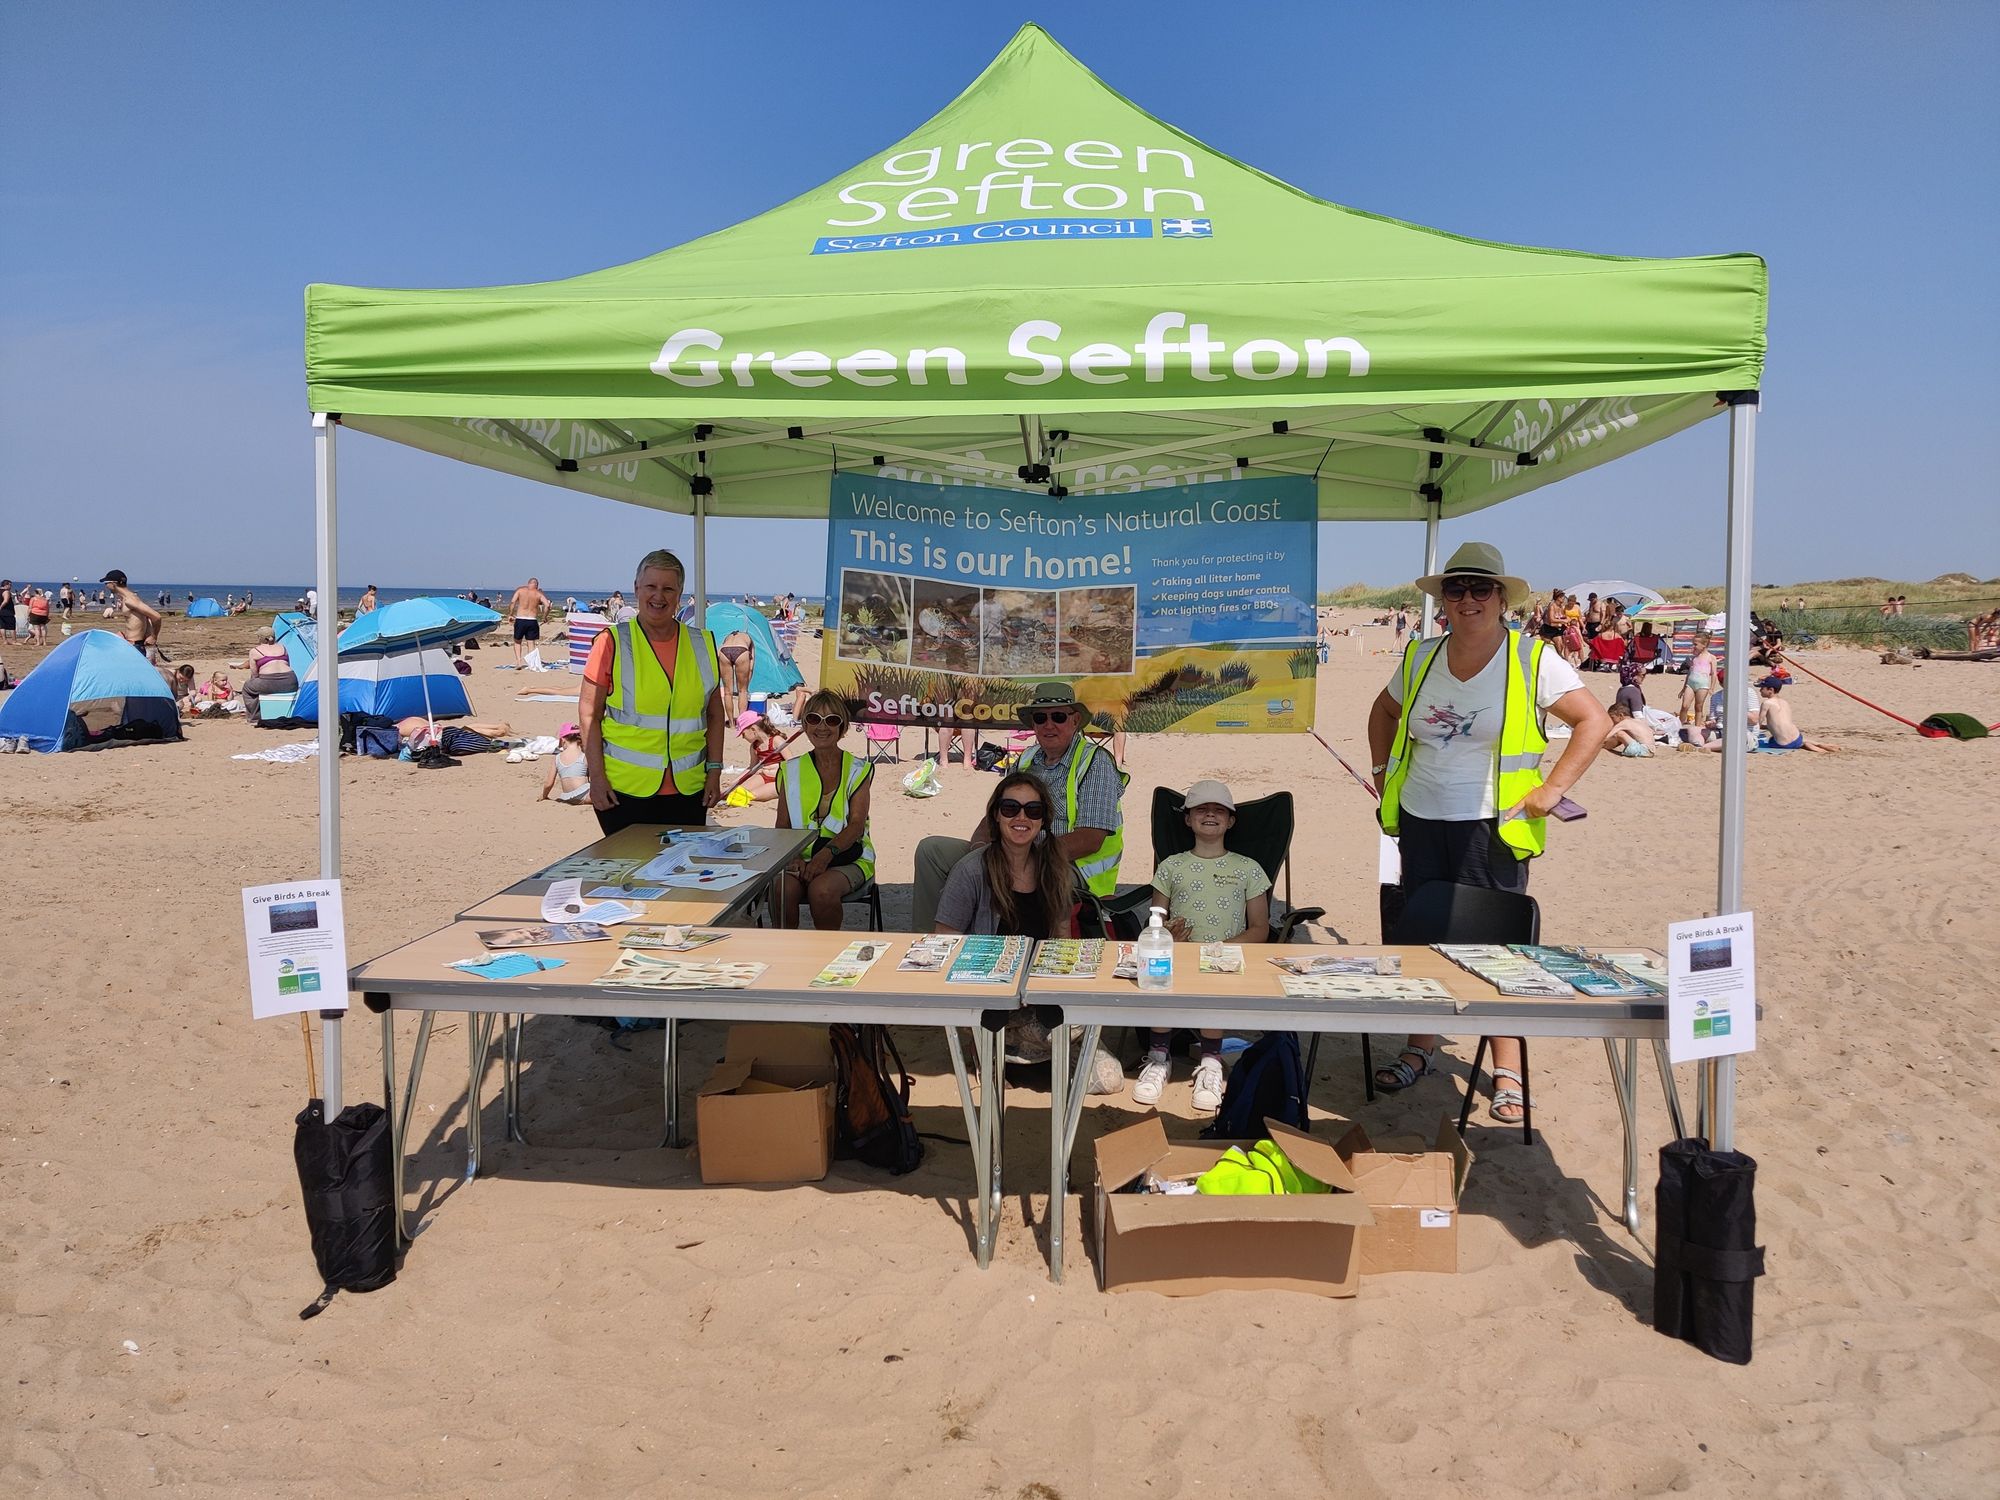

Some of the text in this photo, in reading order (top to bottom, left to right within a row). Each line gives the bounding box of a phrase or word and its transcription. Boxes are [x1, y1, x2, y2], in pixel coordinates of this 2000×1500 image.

[882, 138, 1196, 185] green
[825, 170, 1206, 227] Sefton
[824, 221, 1137, 253] Sefton Council
[649, 312, 1371, 388] Green Sefton
[851, 492, 956, 528] Welcome
[964, 506, 991, 530] to
[1105, 501, 1202, 534] Natural
[1210, 498, 1282, 524] Coast
[850, 529, 1132, 580] This is our home!
[1152, 550, 1286, 569] Thank you for protecting it by
[1160, 571, 1261, 588] Taking all litter home
[1161, 584, 1290, 603] Keeping dogs under control
[1160, 600, 1280, 617] Not lighting fires or BBQs
[867, 691, 1024, 721] SeftonCoas
[252, 895, 272, 904] Give
[274, 892, 296, 901] Birds
[306, 889, 331, 898] Break
[1676, 923, 1744, 941] Give Birds A Break
